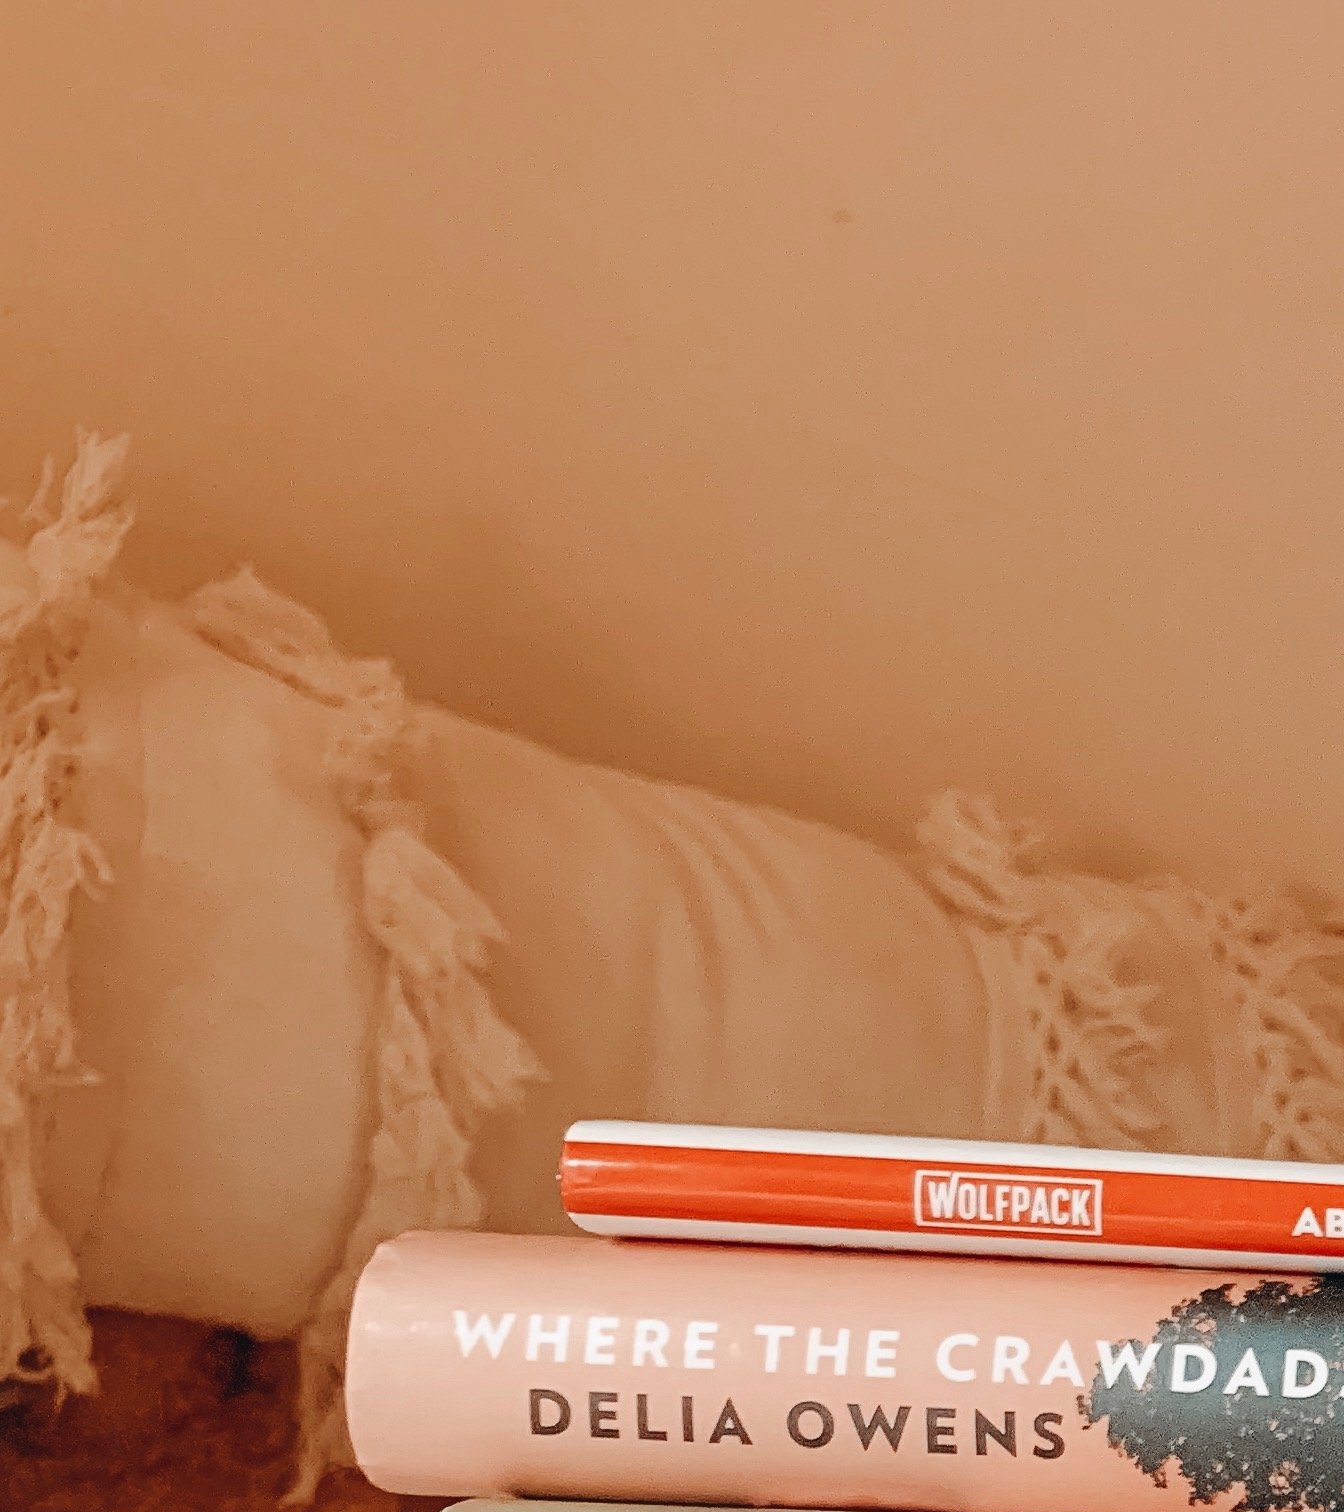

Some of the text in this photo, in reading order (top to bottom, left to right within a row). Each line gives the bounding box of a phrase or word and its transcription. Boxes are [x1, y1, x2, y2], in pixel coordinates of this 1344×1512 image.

[926, 1177, 1091, 1227] WOLFPACK
[452, 1310, 719, 1369] WHERE
[756, 1325, 898, 1378] THE
[528, 1388, 1065, 1459] DELIA OWENS
